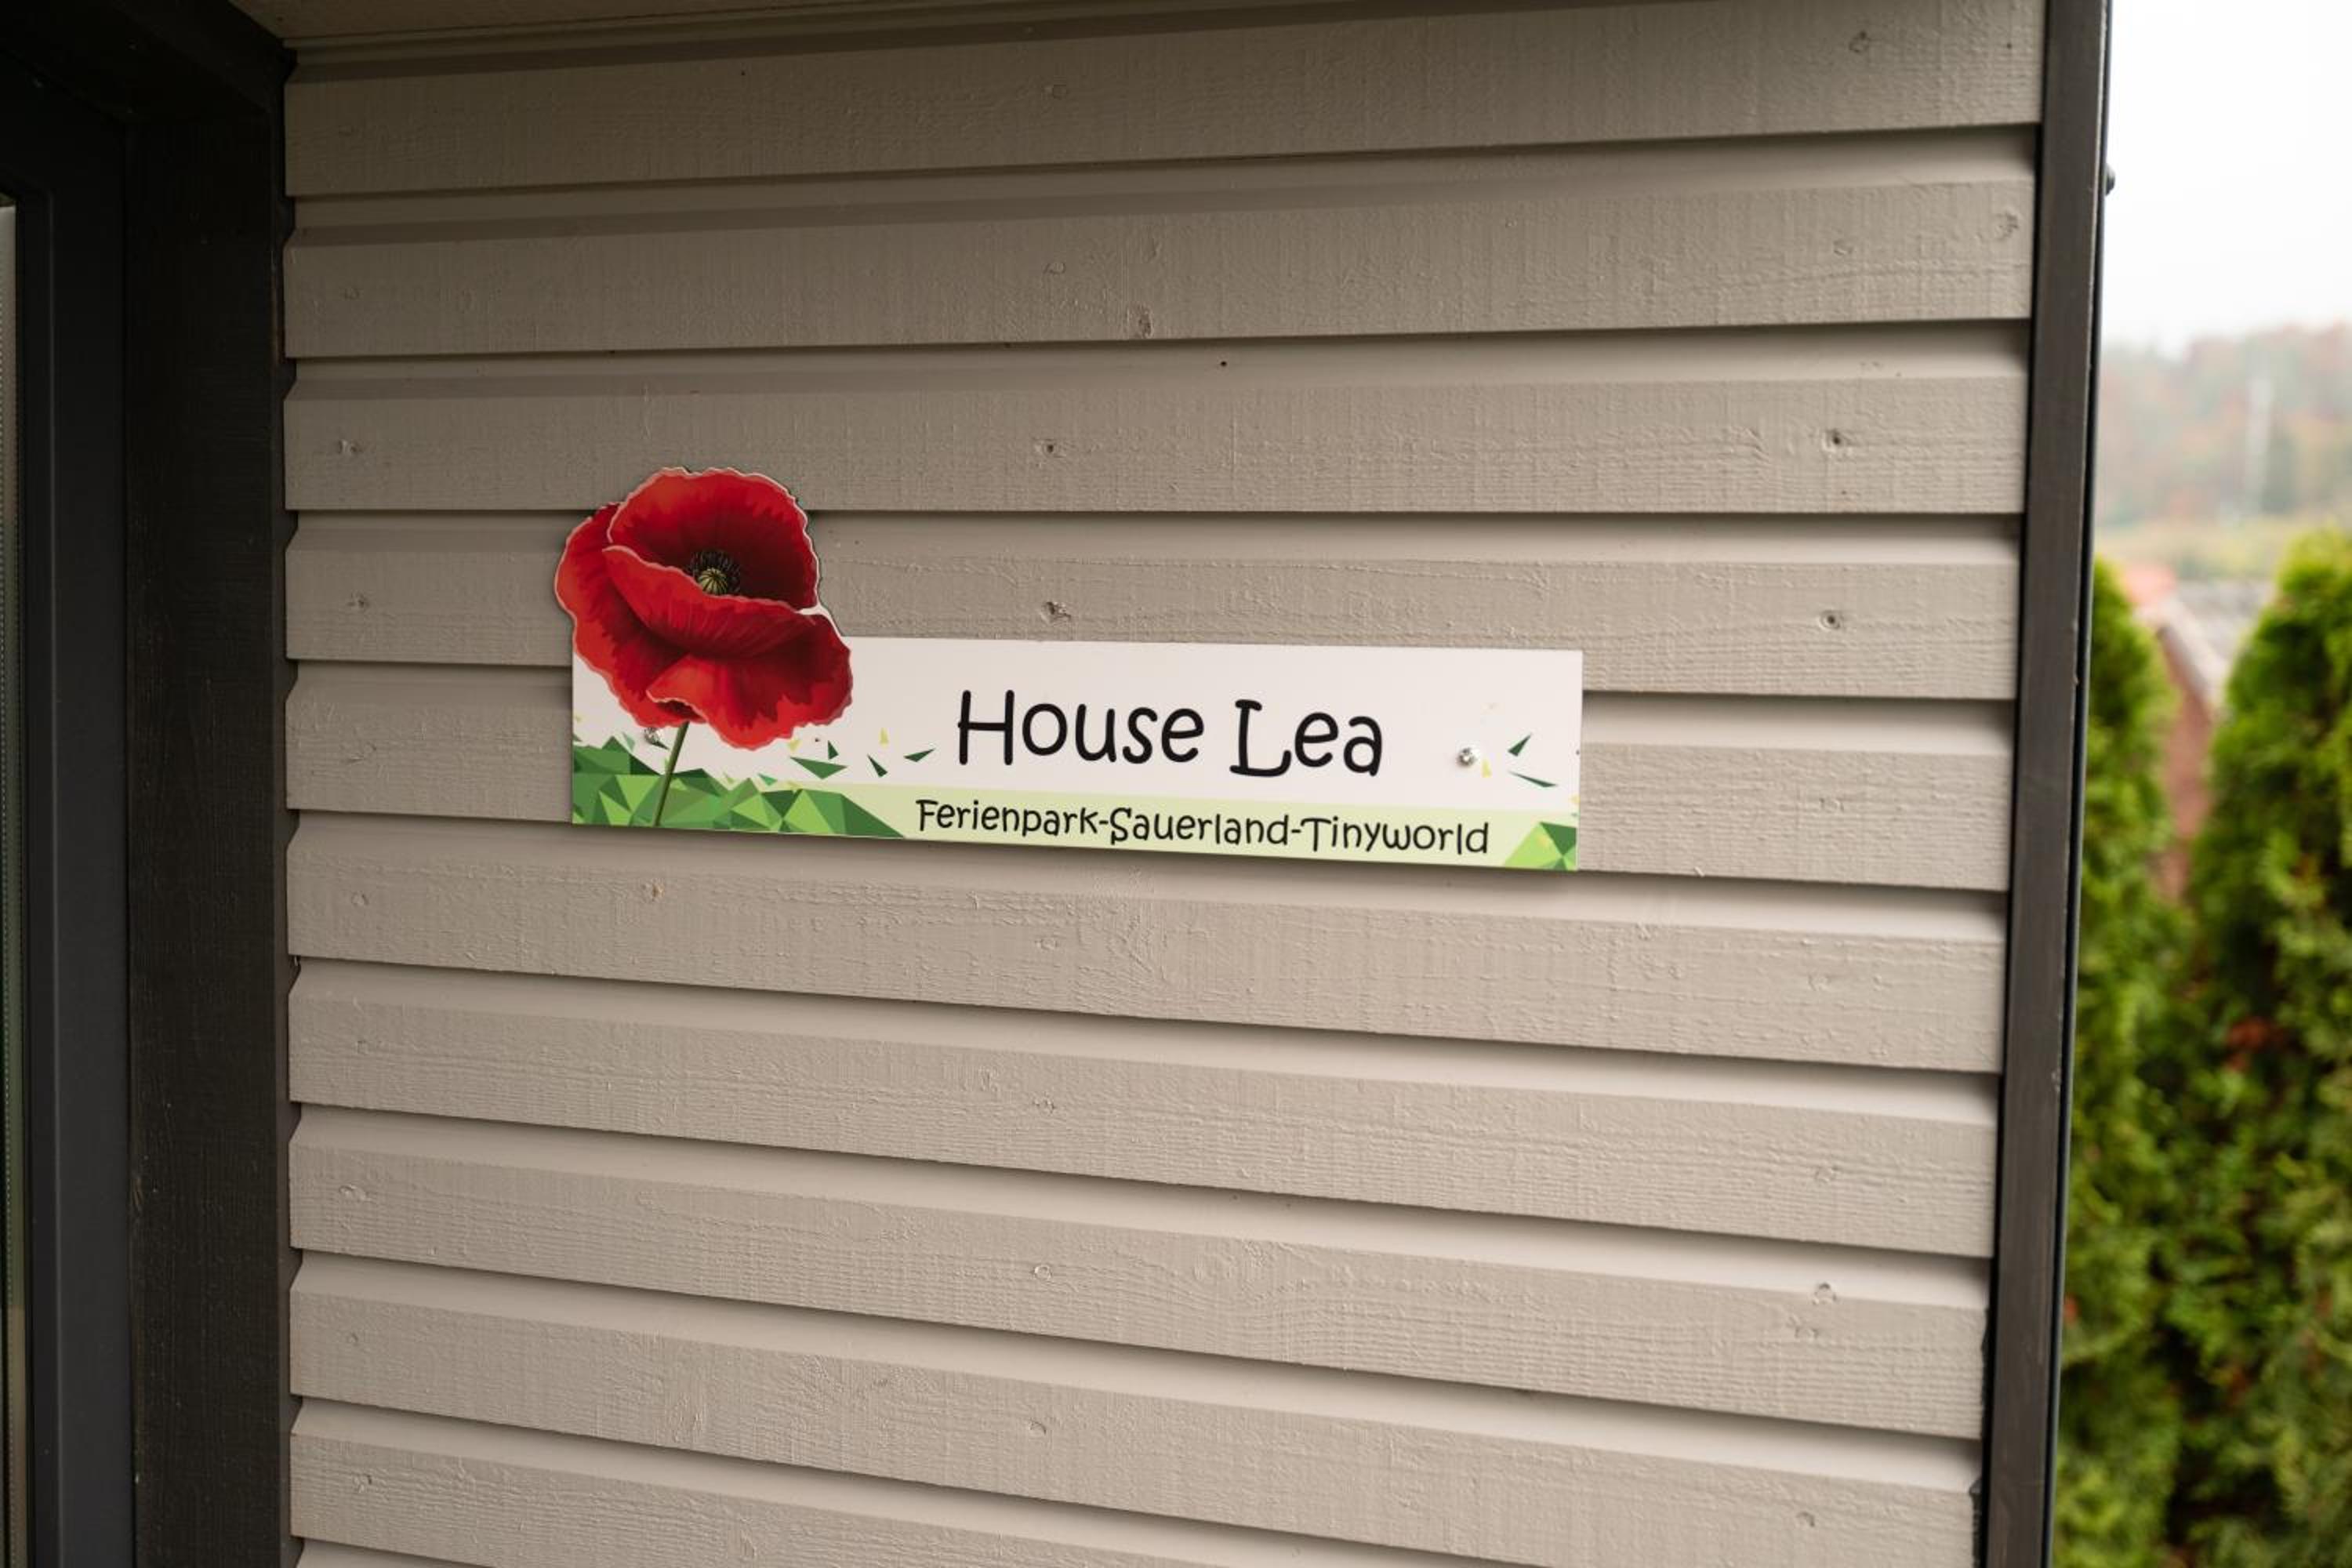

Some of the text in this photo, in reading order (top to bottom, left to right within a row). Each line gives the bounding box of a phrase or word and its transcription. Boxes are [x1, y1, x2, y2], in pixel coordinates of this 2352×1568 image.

[957, 689, 1383, 777] House Lea
[915, 799, 1490, 855] Ferienpark-Sauerland-Tinyworld
